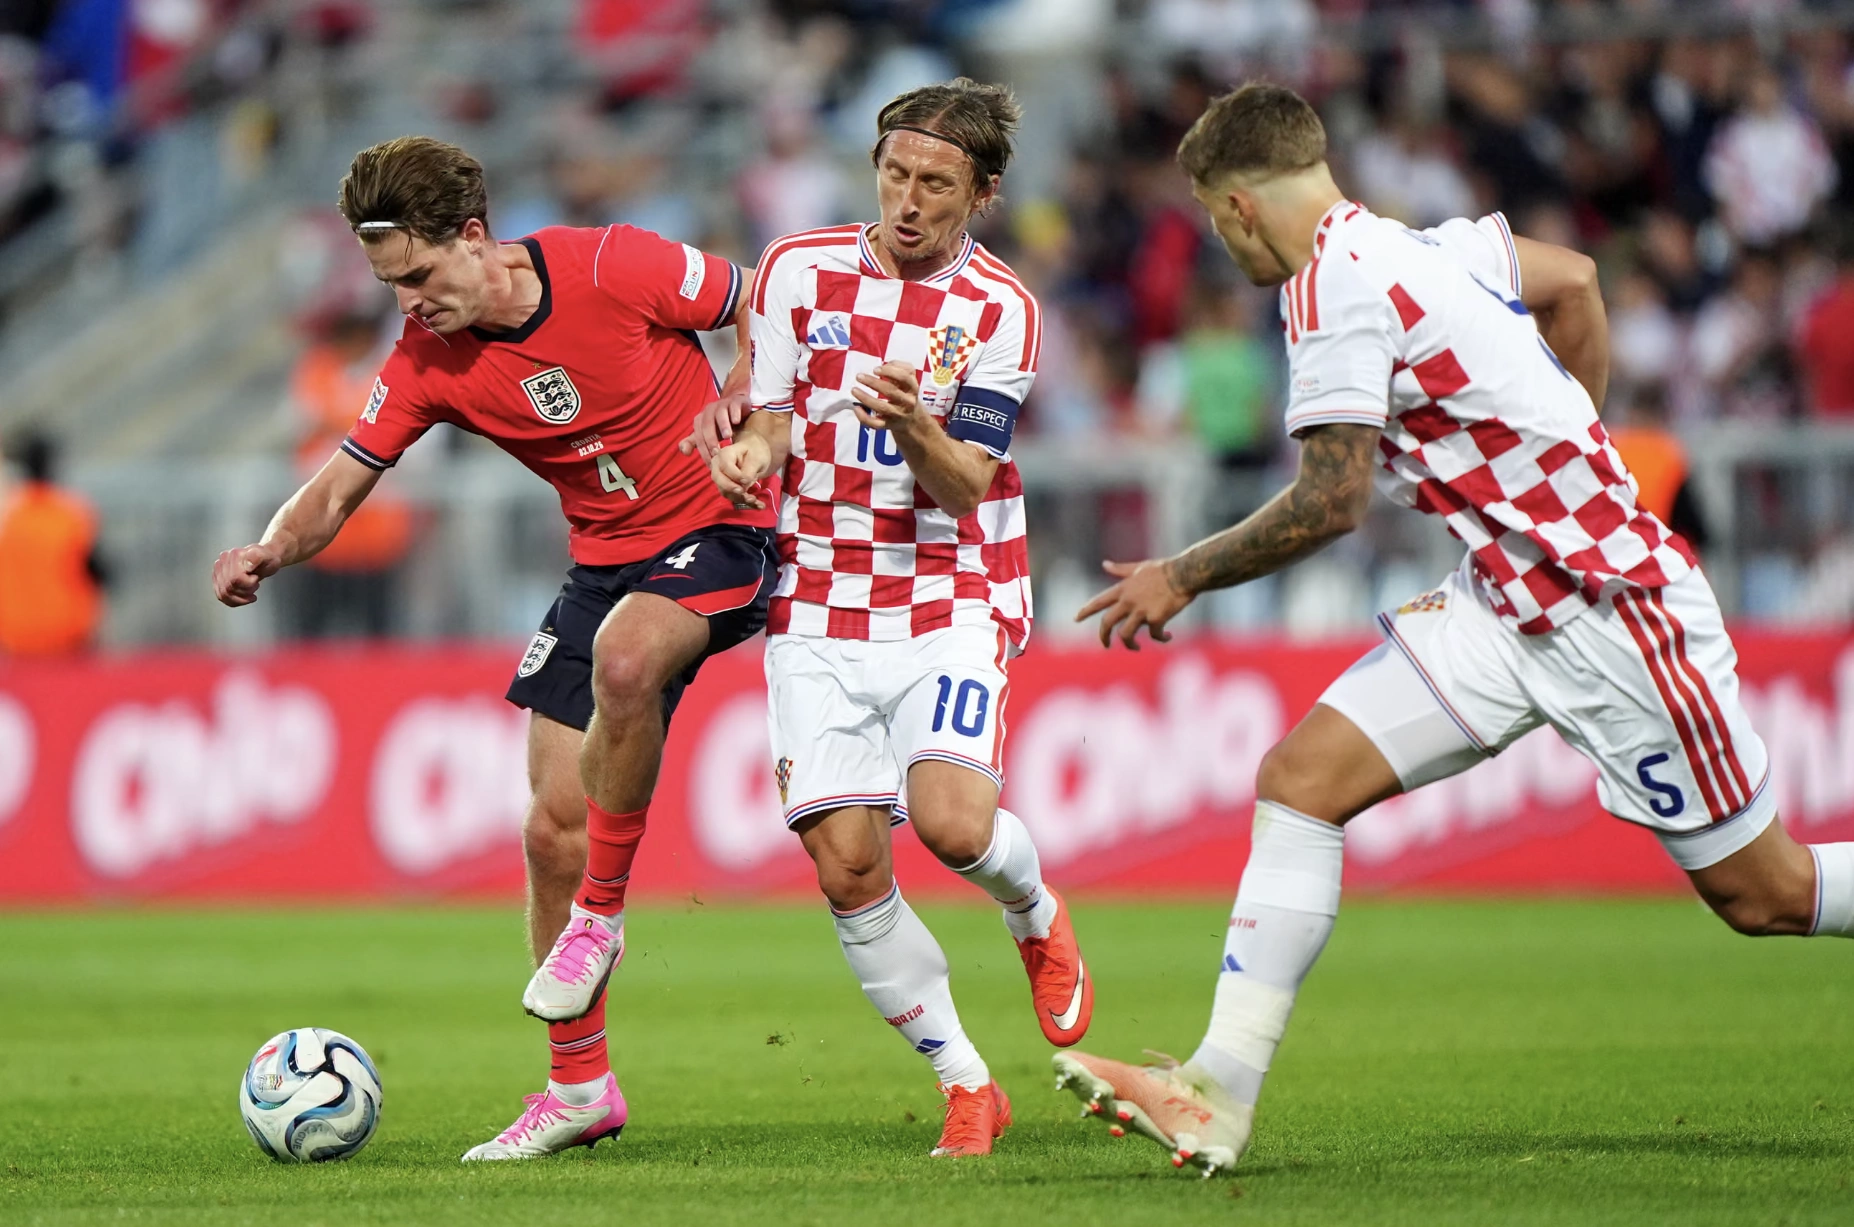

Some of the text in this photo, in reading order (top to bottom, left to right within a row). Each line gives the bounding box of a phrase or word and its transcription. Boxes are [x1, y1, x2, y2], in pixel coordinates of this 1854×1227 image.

[960, 406, 1007, 428] RESPECT
[570, 433, 602, 449] CROATIA
[596, 453, 640, 501] 4
[664, 542, 701, 570] 4
[931, 674, 989, 738] 10
[1636, 752, 1685, 818] 5
